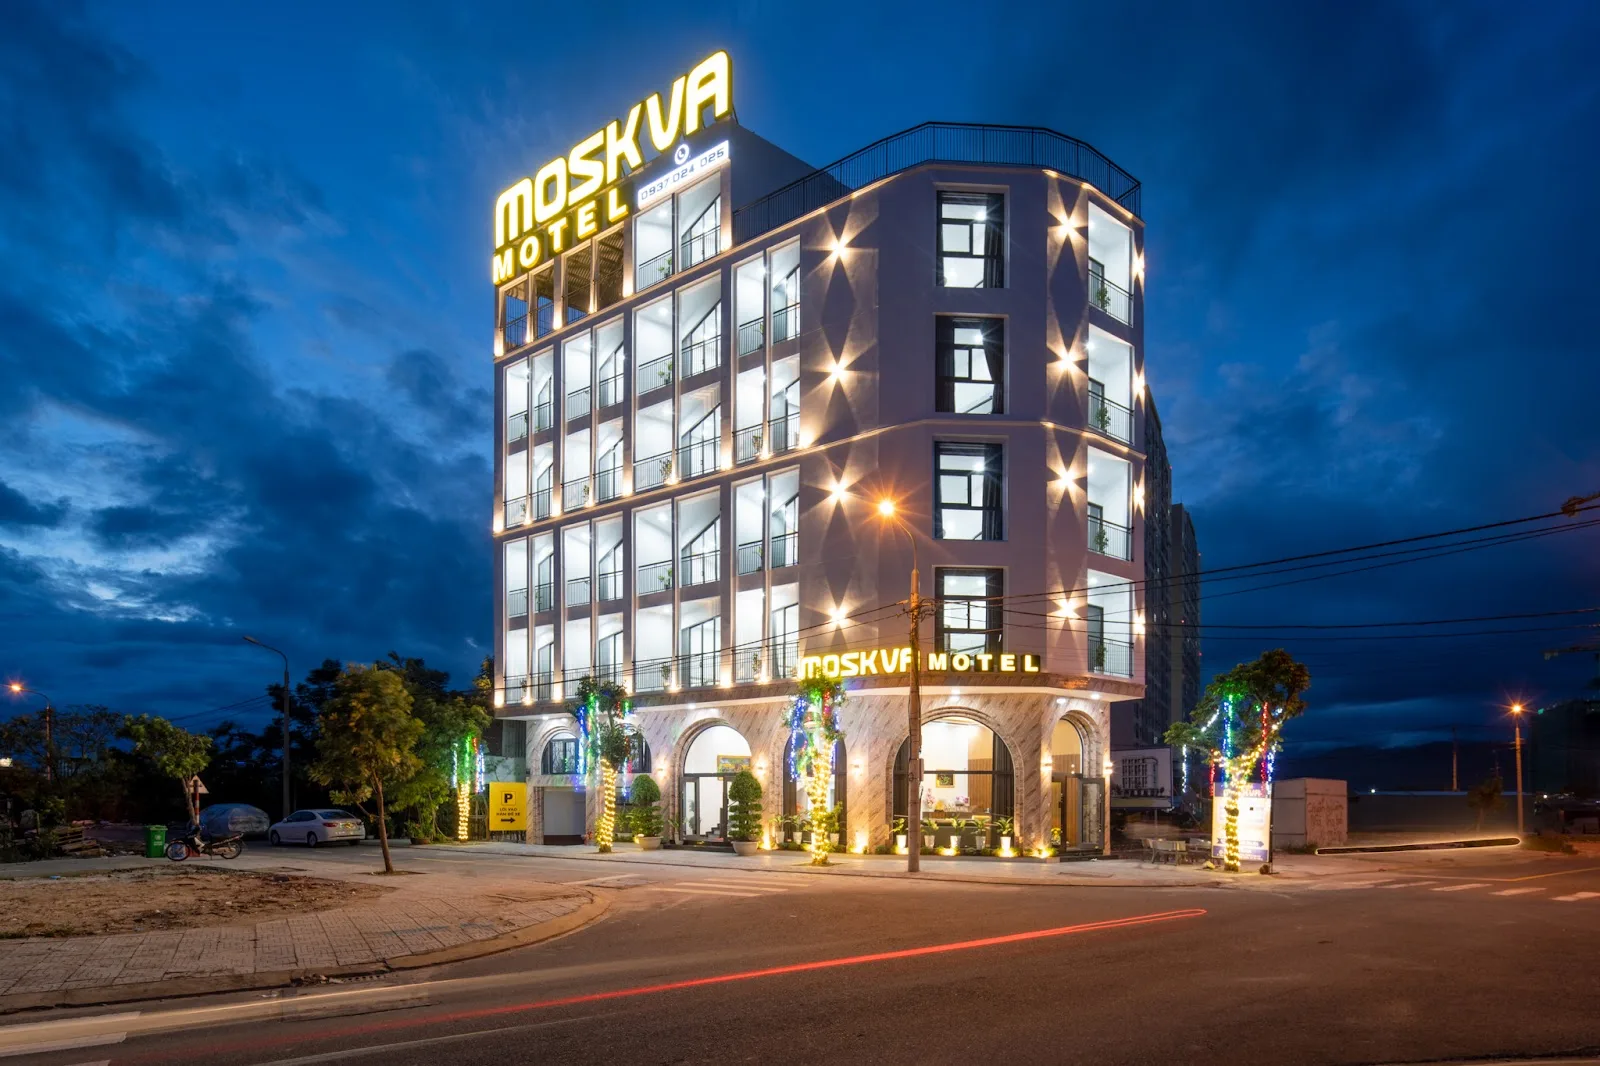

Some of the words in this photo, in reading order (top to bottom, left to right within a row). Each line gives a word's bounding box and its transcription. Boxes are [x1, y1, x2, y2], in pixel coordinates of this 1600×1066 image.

[495, 50, 731, 249] MOSKVA
[641, 178, 670, 200] 0937
[672, 164, 695, 183] 024
[700, 147, 724, 168] 025
[493, 187, 628, 285] MOTEL
[928, 653, 1039, 672] MOTEL
[504, 793, 513, 803] P
